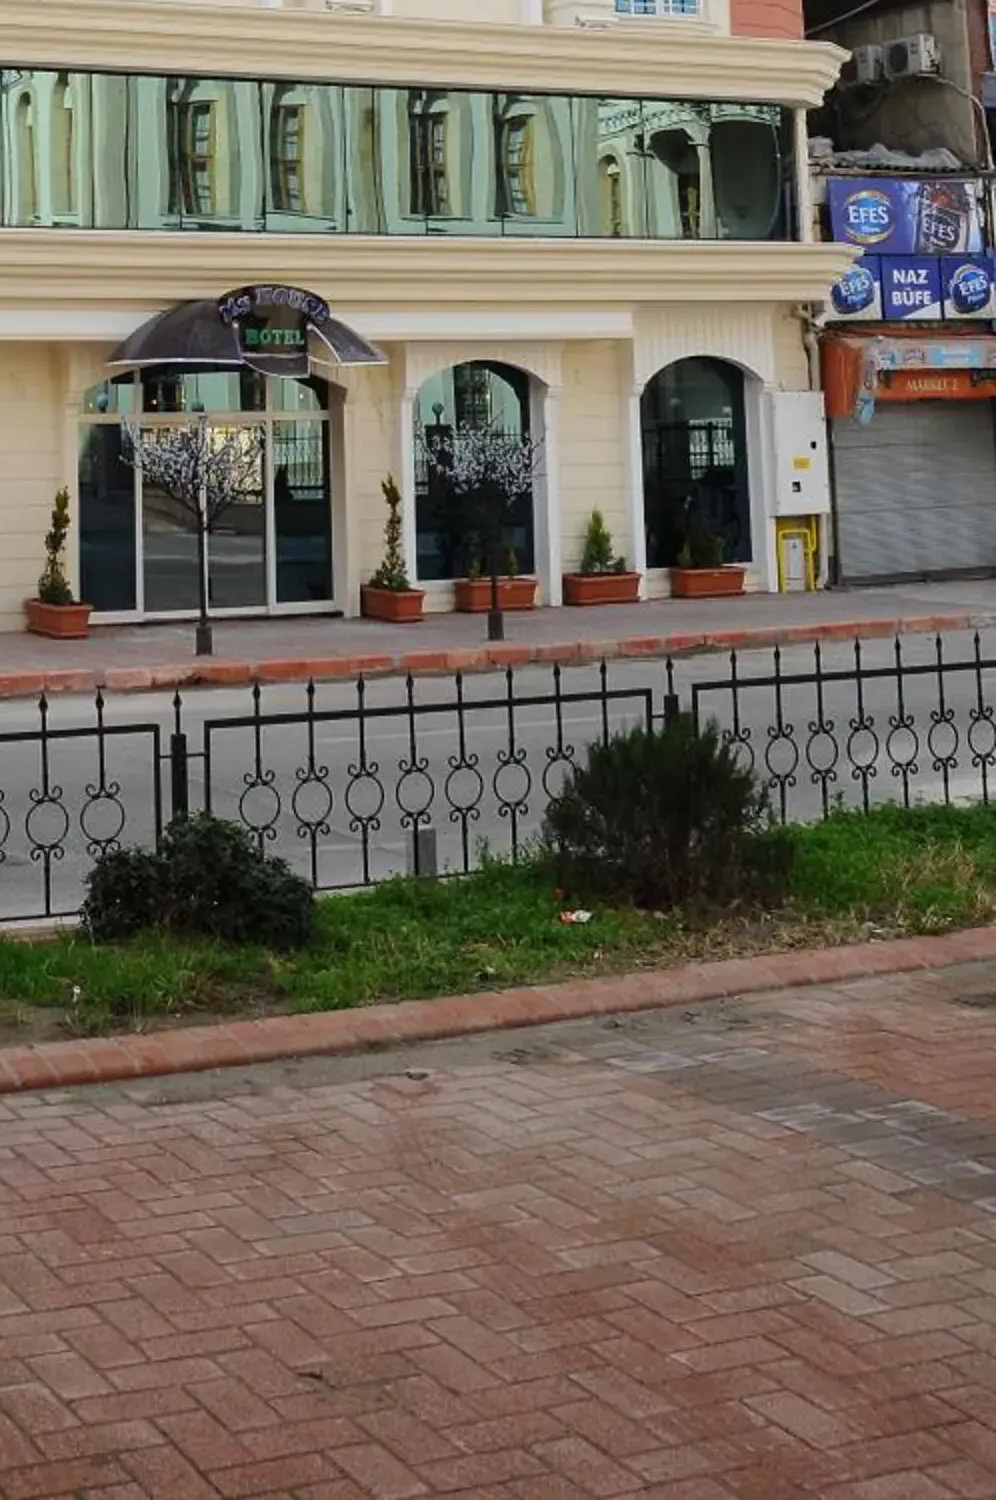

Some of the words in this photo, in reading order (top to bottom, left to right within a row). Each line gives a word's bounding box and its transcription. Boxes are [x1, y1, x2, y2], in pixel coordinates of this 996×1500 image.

[848, 205, 889, 225] EFES
[924, 214, 955, 242] EFES
[839, 275, 870, 297] EFES
[893, 269, 929, 284] NAZ
[959, 275, 988, 296] EFES
[891, 287, 932, 306] BÜFE
[245, 329, 305, 345] HOTEL
